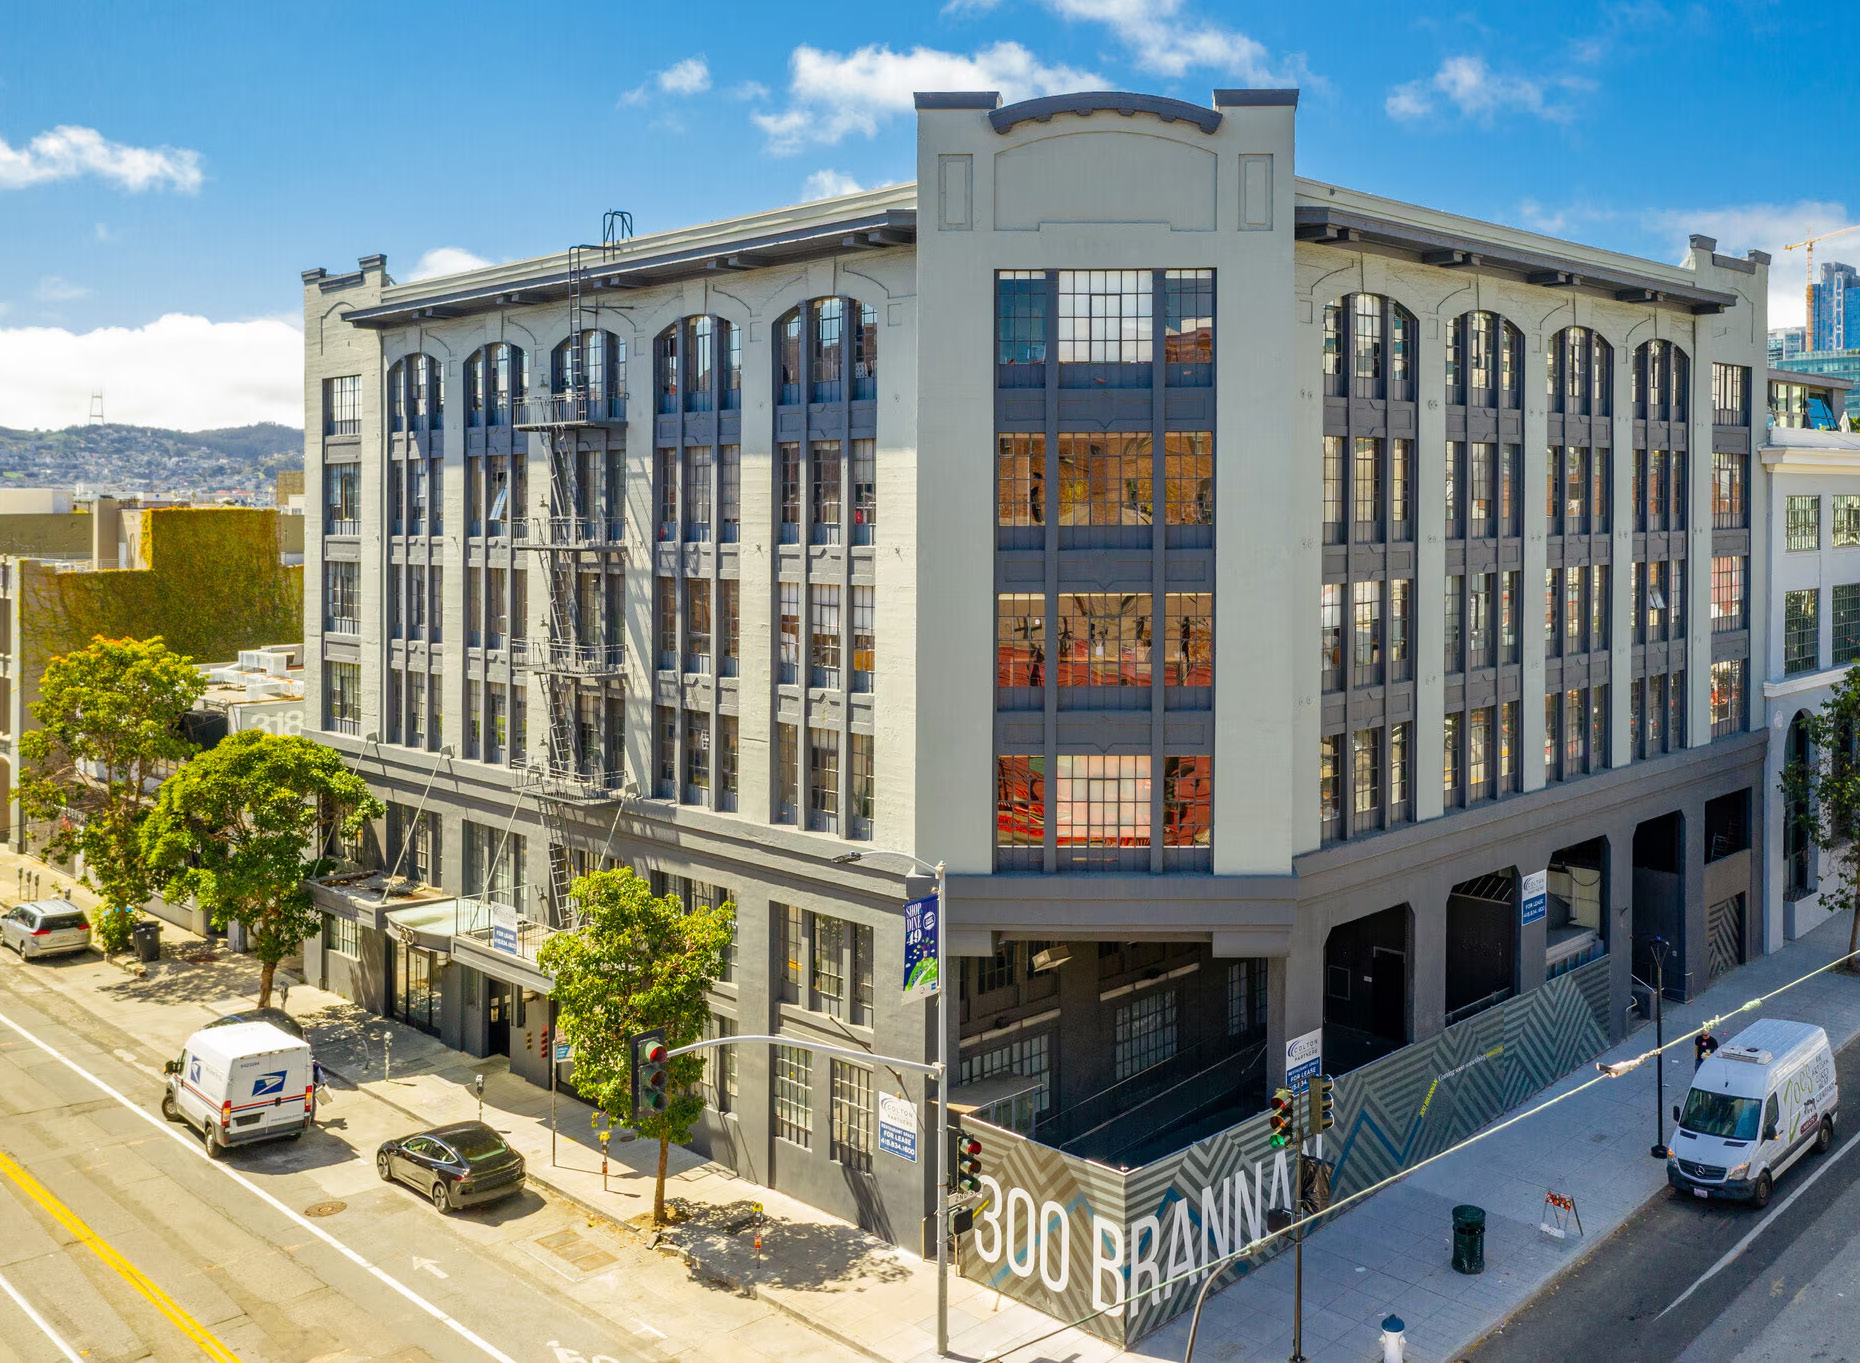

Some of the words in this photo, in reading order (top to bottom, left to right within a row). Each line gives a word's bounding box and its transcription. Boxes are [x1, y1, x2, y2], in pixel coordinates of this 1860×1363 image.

[251, 710, 304, 736] 318
[906, 902, 922, 918] SHOP
[906, 915, 922, 933] DINE
[906, 929, 922, 946] 49
[1294, 1039, 1318, 1053] COLTON
[1294, 1050, 1318, 1062] PARTNERS
[1290, 1074, 1301, 1082] FOR
[1301, 1066, 1317, 1078] LEASE
[887, 1104, 913, 1118] COLTON
[883, 1130, 894, 1139] FOR
[895, 1134, 912, 1146] LEASE
[955, 1191, 968, 1203] 2ND
[974, 1174, 1070, 1292] 300
[1093, 1134, 1324, 1317] BRANNA
